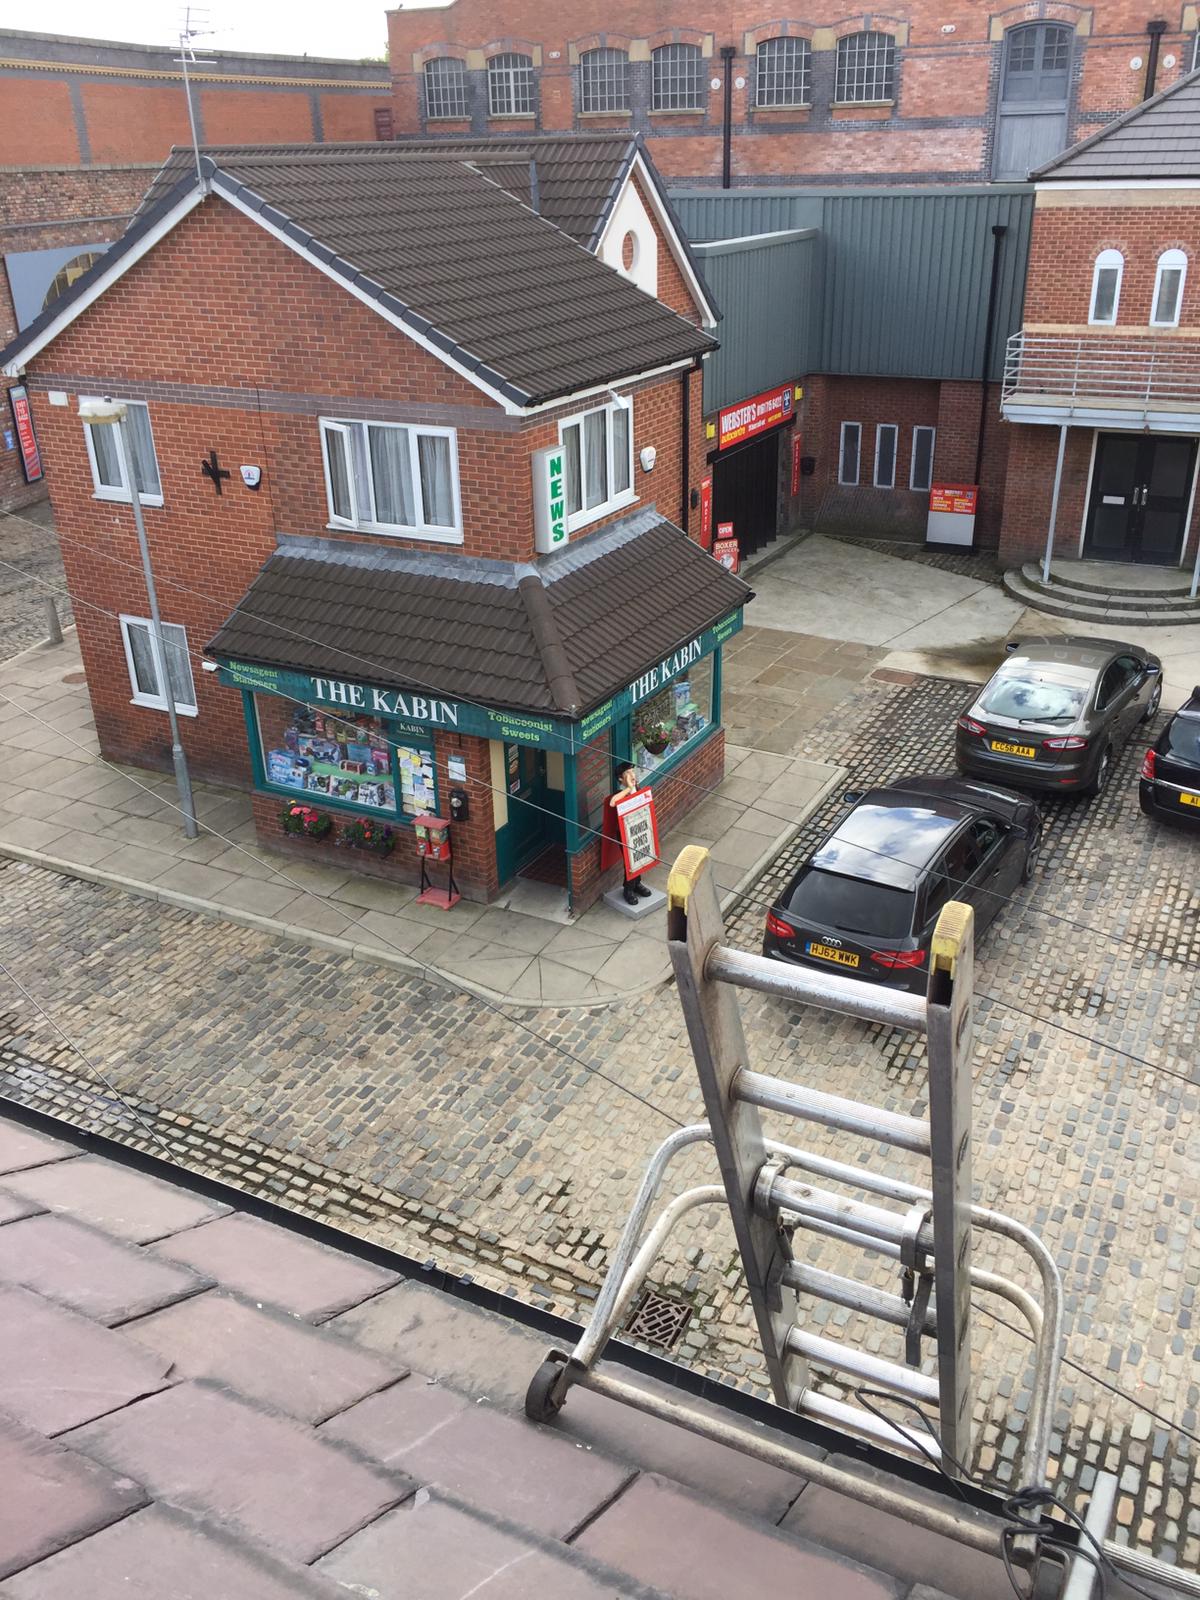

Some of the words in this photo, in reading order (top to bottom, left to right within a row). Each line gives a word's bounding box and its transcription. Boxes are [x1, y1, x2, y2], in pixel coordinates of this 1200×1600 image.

[722, 403, 756, 434] WEBSTER'S
[550, 456, 564, 542] NEWS
[715, 541, 737, 550] BOXER
[229, 661, 278, 678] Newsagent
[629, 667, 658, 704] THE
[661, 636, 702, 683] KABIN
[310, 677, 365, 707] THE
[372, 689, 458, 726] KABIN
[488, 712, 553, 731] Tobacconist
[581, 699, 613, 727] Newsagent
[400, 723, 424, 734] KABIN
[501, 727, 540, 741] Sweets
[582, 715, 612, 740] Stationers
[1016, 746, 1030, 755] AAA
[633, 833, 648, 849] SPORTS
[811, 944, 836, 960] HJ62
[838, 952, 857, 965] WWK
